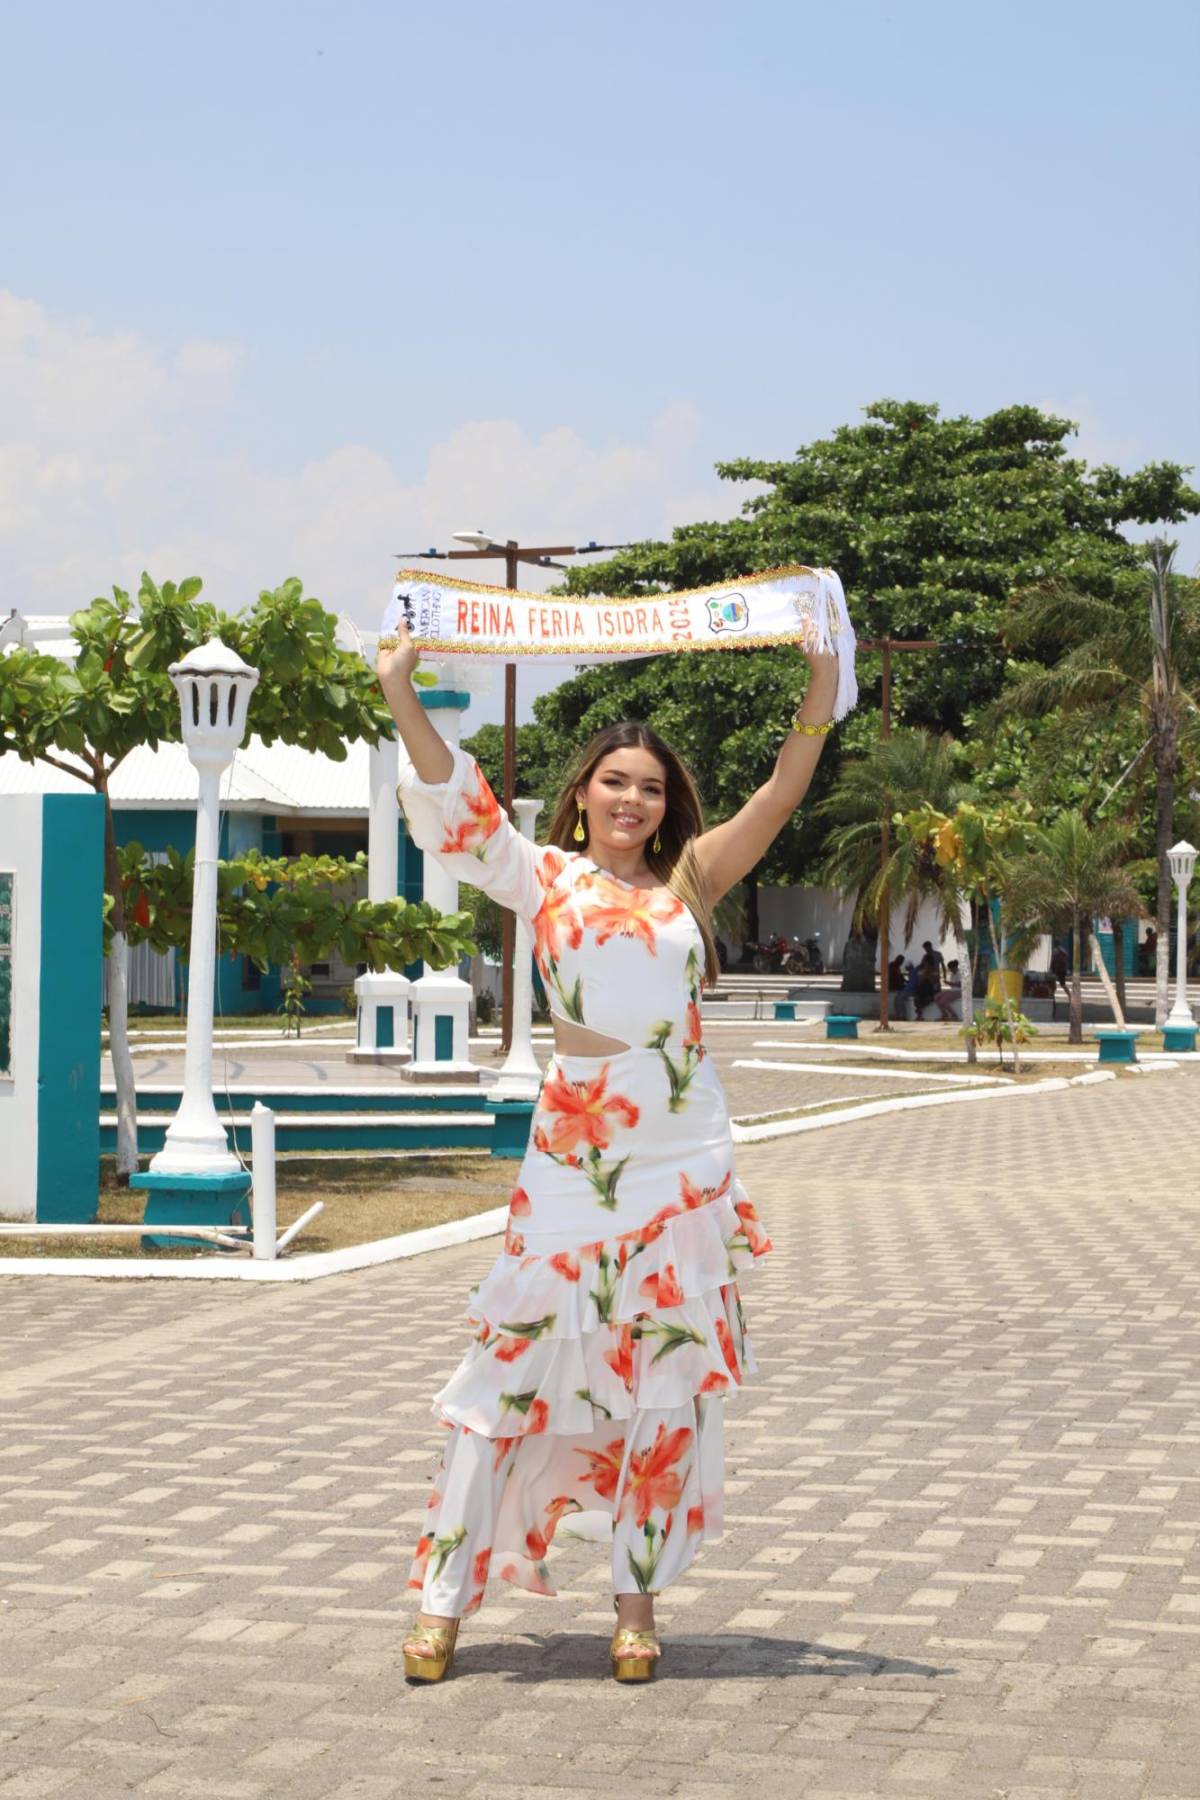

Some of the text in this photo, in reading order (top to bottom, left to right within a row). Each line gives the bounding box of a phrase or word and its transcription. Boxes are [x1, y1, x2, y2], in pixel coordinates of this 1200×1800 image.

[457, 599, 664, 637] REINA FERIA ISIDRA
[668, 599, 692, 640] 2025
